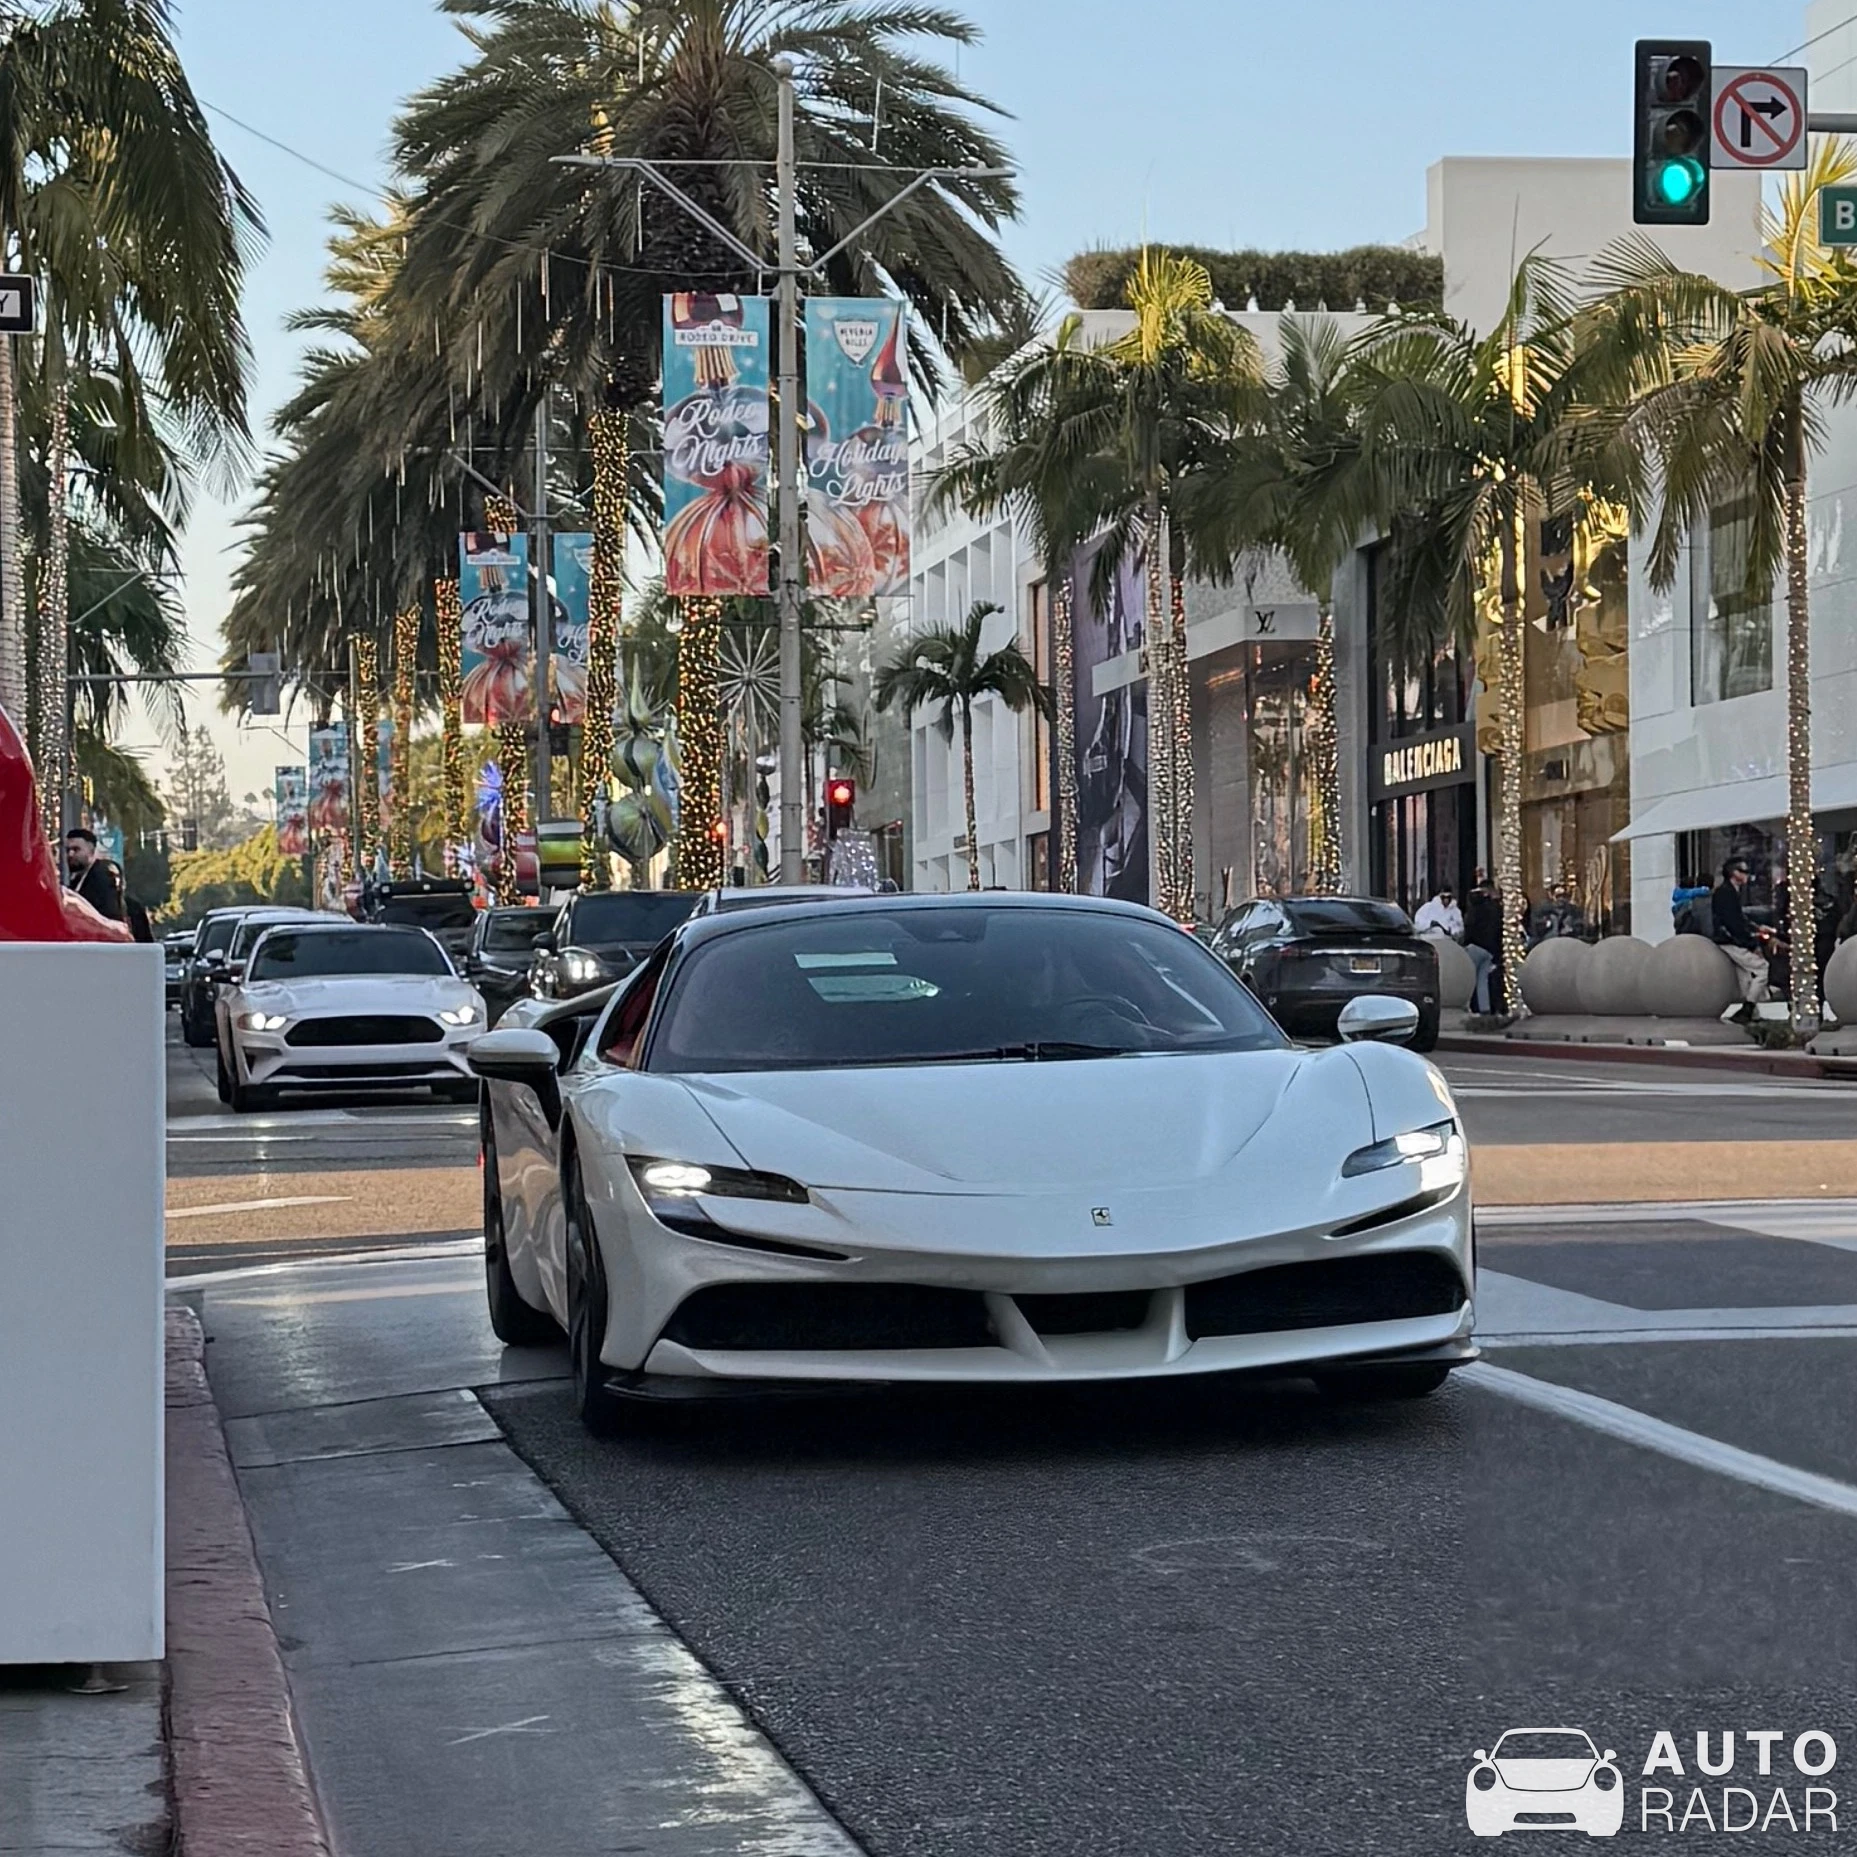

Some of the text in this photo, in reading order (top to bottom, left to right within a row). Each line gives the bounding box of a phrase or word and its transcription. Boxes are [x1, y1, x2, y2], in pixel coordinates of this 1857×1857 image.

[1835, 200, 1856, 230] B
[679, 398, 758, 439] Rodeo
[671, 434, 764, 477] Nights
[809, 439, 907, 479] Holiday
[826, 470, 907, 507] Lights
[1384, 736, 1461, 786] BALENCIAGA
